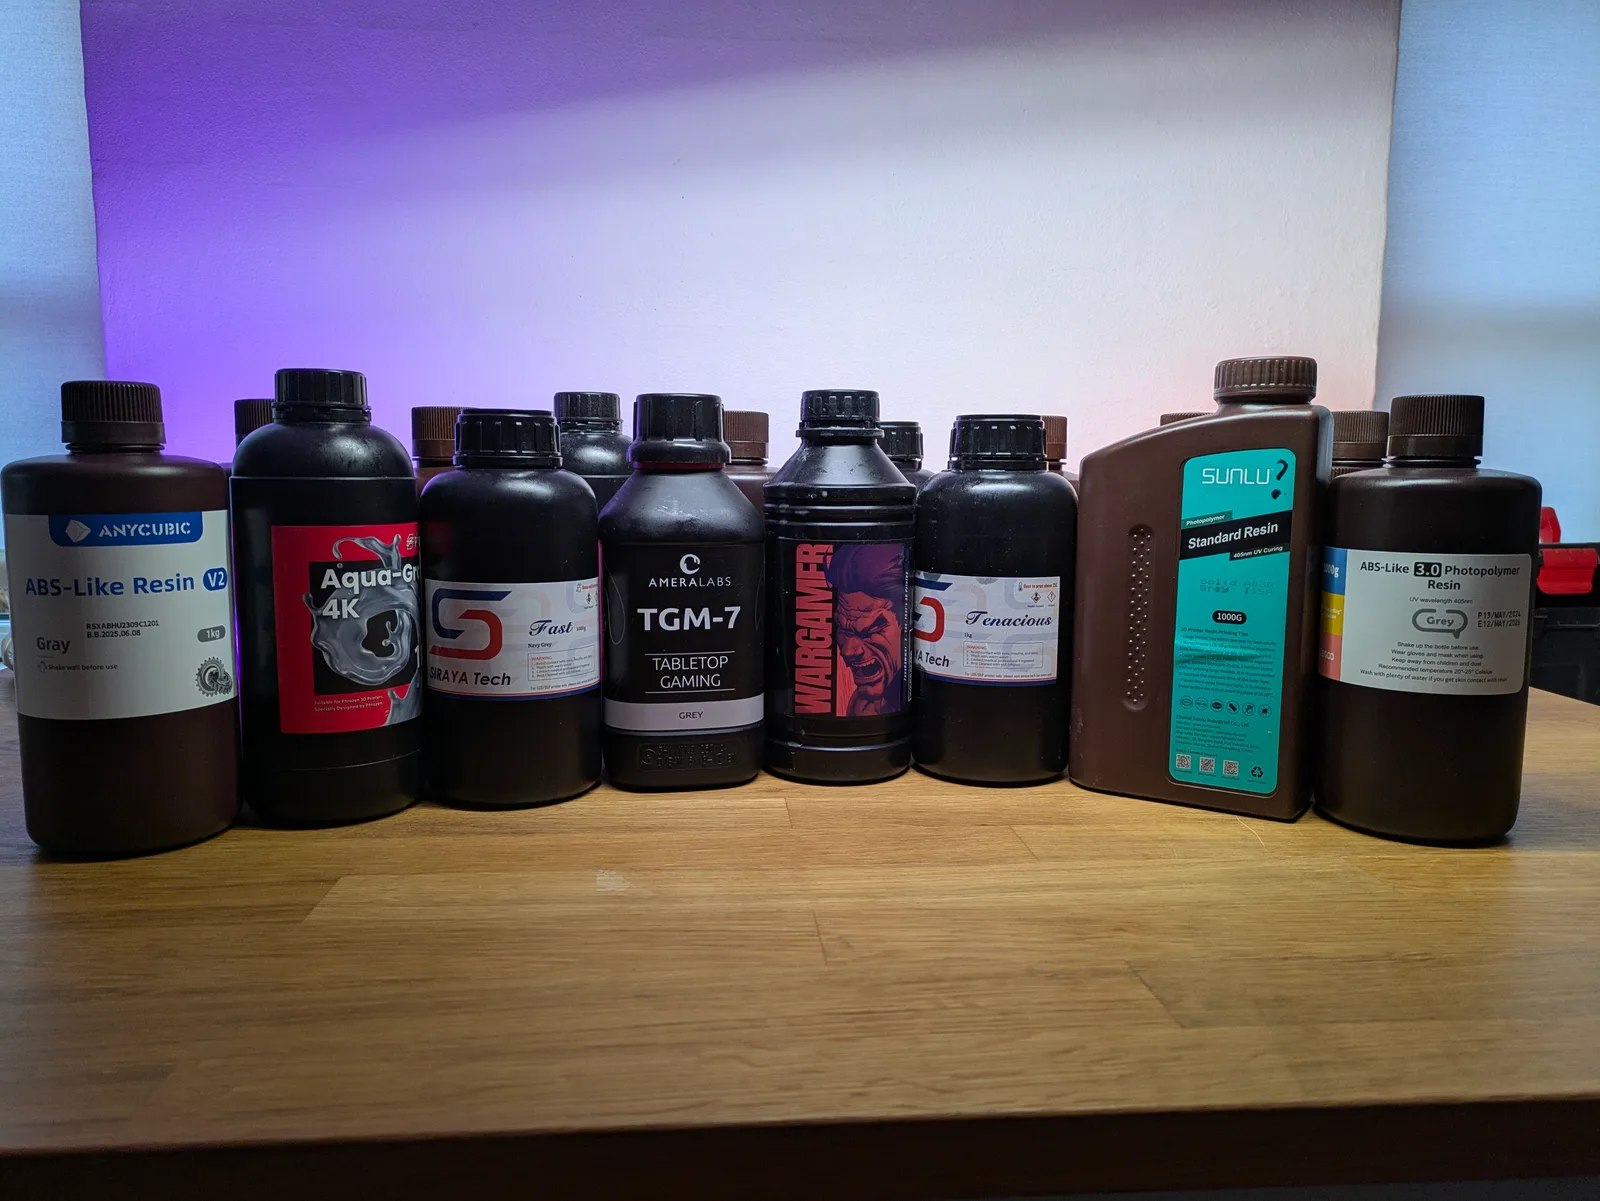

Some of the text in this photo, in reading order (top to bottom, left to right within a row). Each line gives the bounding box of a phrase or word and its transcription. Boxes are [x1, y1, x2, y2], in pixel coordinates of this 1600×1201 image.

[1202, 468, 1270, 485] SUNLU
[1185, 514, 1226, 526] Photopolymer
[98, 522, 191, 538] ANYCUBIC
[1188, 522, 1279, 549] Standard Resin
[1263, 546, 1283, 554] Curing
[1360, 561, 1520, 578] ABS-Like 3.0 Photopolymer
[25, 571, 226, 597] ABS-Like Resin V2
[320, 563, 421, 595] Aqua-Gr
[648, 576, 732, 588] AMERALABS
[1427, 580, 1461, 590] Resin
[322, 598, 360, 620] 4K
[1216, 612, 1243, 622] 1000G
[86, 620, 160, 630] RSXABHU2309C1201
[636, 606, 742, 632] TGM-7
[965, 610, 1053, 626] Tenacious
[1426, 616, 1454, 628] Grey
[206, 628, 220, 640] 1kg
[528, 619, 574, 636] Fast
[794, 542, 834, 714] WARGAMER
[36, 636, 71, 654] Gray
[652, 655, 729, 671] TABLETOP
[925, 652, 950, 668] Tech
[1378, 663, 1418, 672] Recommended
[429, 666, 512, 686] SIRAYA Tech
[660, 674, 722, 688] GAMING
[678, 710, 704, 720] GREY
